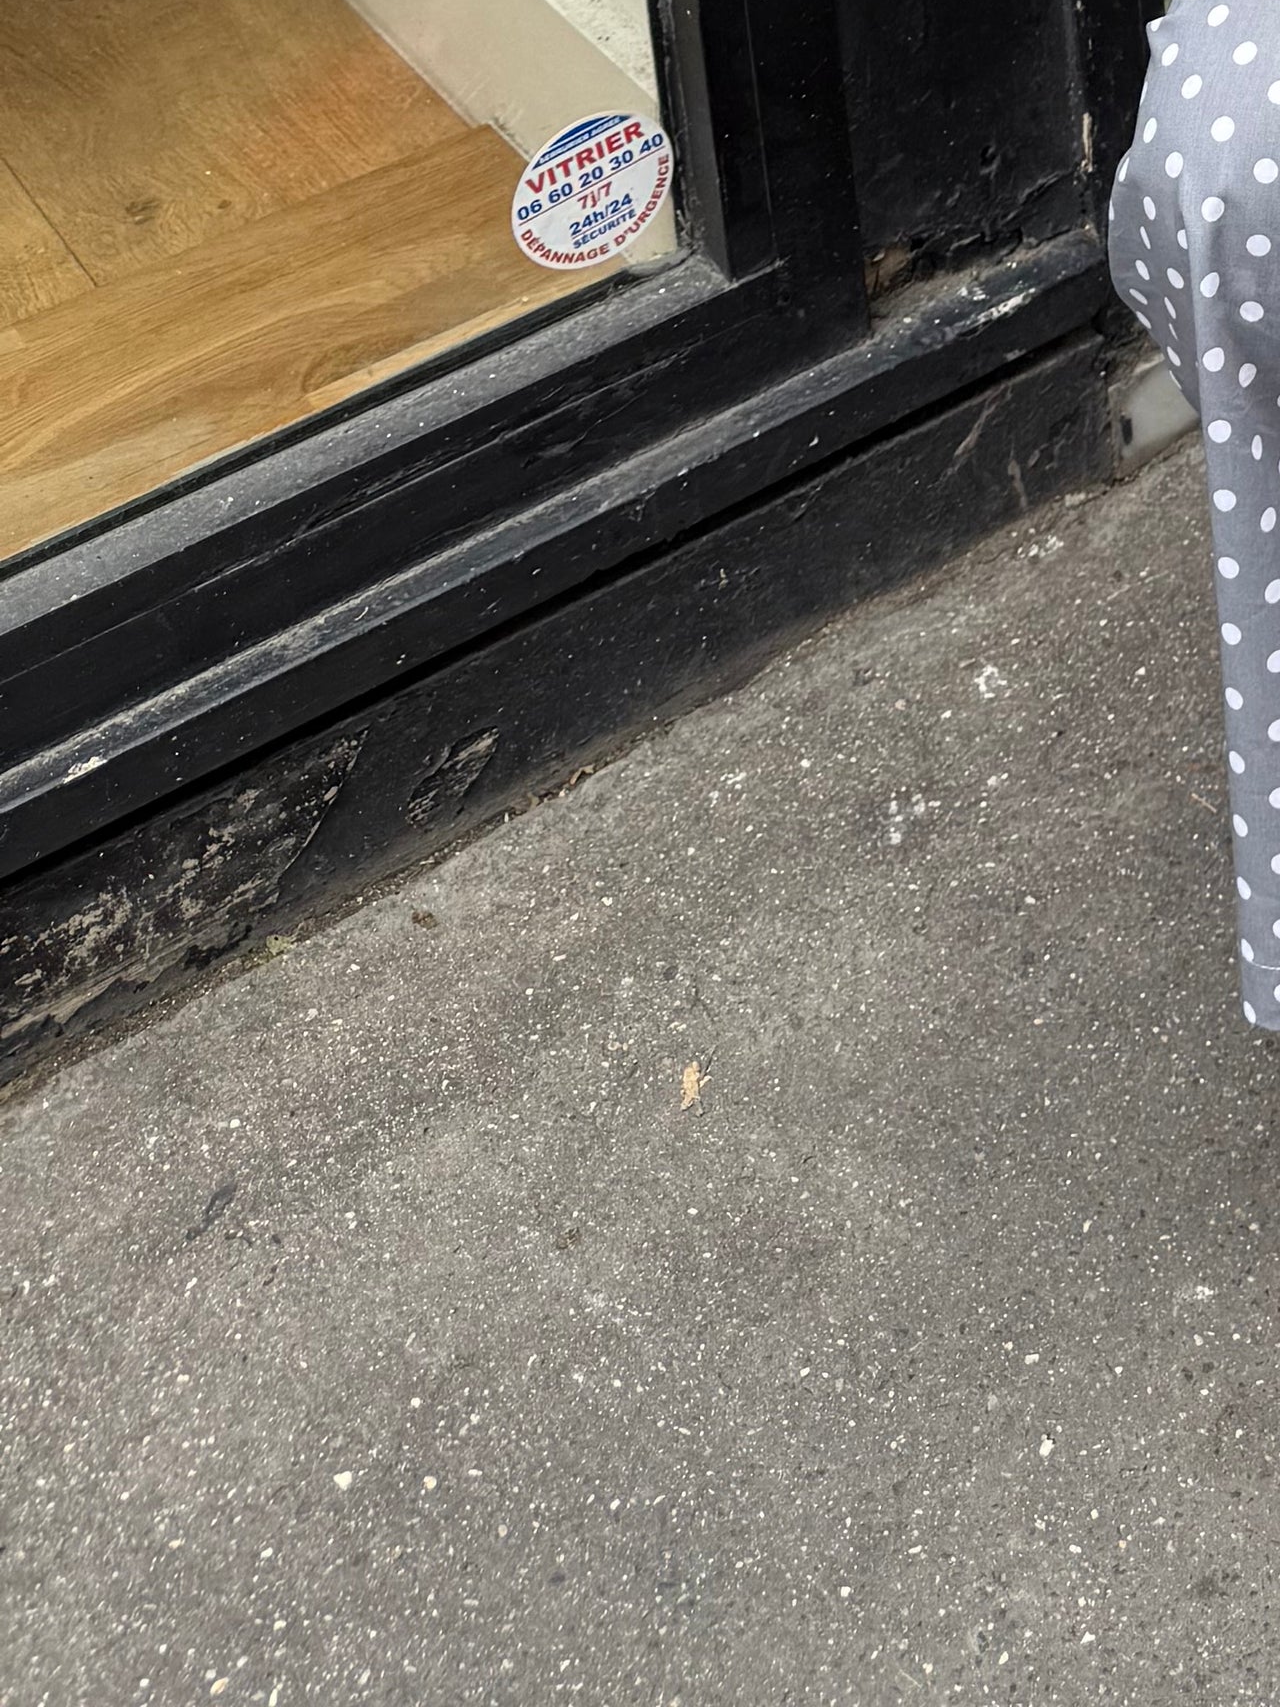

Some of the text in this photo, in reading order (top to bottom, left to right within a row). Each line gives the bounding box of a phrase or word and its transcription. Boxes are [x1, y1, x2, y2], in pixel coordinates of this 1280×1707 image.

[517, 198, 542, 221] 06
[548, 182, 573, 204] 60
[579, 166, 604, 189] 20
[609, 149, 634, 171] 30
[639, 133, 664, 156] 40
[525, 121, 645, 195] VITRIER
[569, 192, 633, 237] 24h/24
